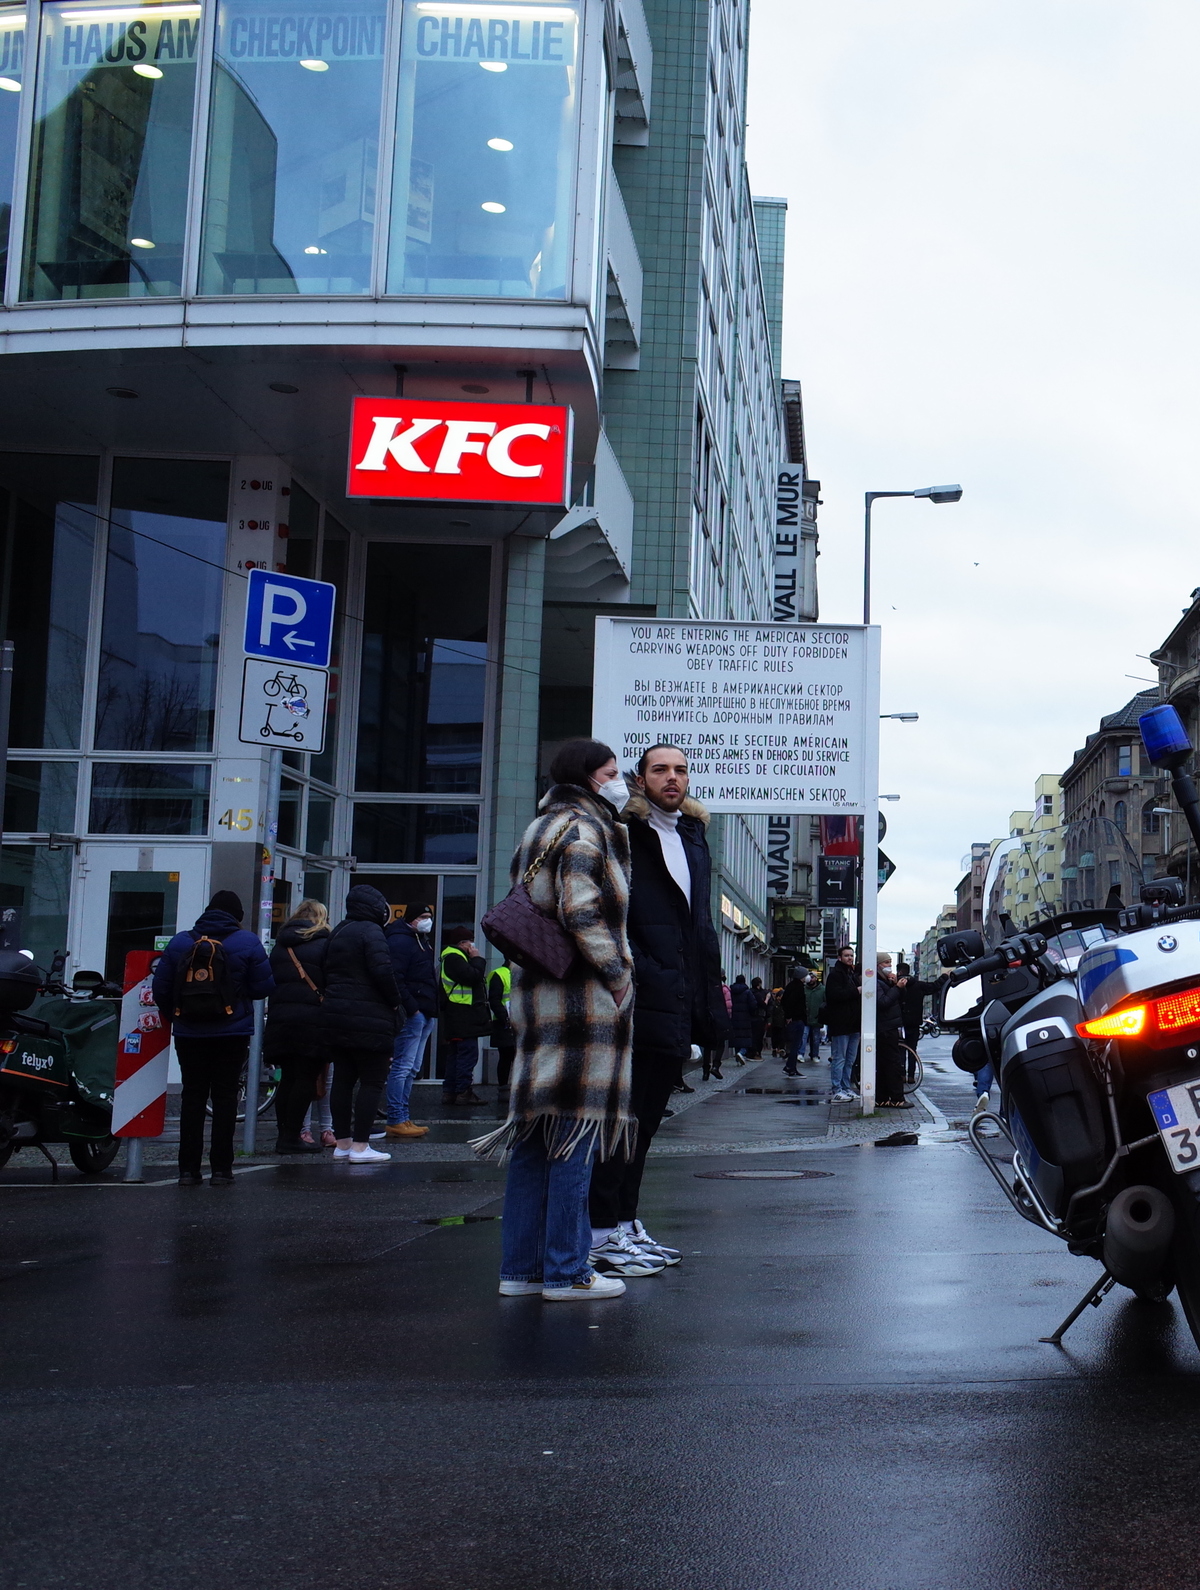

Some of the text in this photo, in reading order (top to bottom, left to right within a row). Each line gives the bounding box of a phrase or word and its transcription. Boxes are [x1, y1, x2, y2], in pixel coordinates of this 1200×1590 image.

[62, 20, 148, 66] HAUS
[230, 16, 387, 59] CHECKPOINT
[416, 15, 565, 61] CHARLIE
[355, 416, 551, 478] KFC
[240, 480, 273, 490] 2 UG
[777, 471, 800, 527] MUR
[240, 520, 270, 530] 3 UG
[775, 533, 798, 557] LE
[259, 583, 308, 647] P
[631, 626, 850, 644] YOU ARE ENTERING THE AMERICAN SECTOR
[630, 642, 848, 659] CARRYING WEAPONS OFF DUTY FORBIDDEN
[687, 658, 794, 672] OBEY TRAFFIC RULES
[634, 680, 650, 692] ВЫ
[712, 682, 718, 694] В
[723, 682, 803, 696] АМЕРИКАНСКИЙ
[808, 684, 843, 696] СЕКТОР
[624, 694, 657, 707] НОСИТЬ
[660, 695, 694, 708] ОРУЖИЕ
[750, 698, 756, 710] В
[759, 698, 820, 711] НЕСЛУЖЕБНОЕ
[822, 699, 851, 712] ВРЕМЯ
[714, 712, 772, 724] ДОРОЖНЫМ
[778, 713, 834, 726] ПРАВИЛАМ
[624, 732, 848, 748] VOUS ENTREZ DANS LE SECTEUR AMÉRICAIN
[705, 748, 720, 760] DES
[722, 749, 750, 760] ARMES
[752, 750, 763, 760] EN
[766, 750, 798, 761] DEHORS
[802, 750, 814, 762] DU
[816, 751, 850, 762] SERVICE
[690, 762, 836, 776] AUX REGLES DE CIRCULATION
[696, 786, 714, 800] DEN
[719, 786, 805, 800] AMERIKANISCHEN
[810, 788, 846, 802] SEKTOR
[218, 808, 253, 831] 45
[22, 1052, 48, 1071] felyx
[1162, 1113, 1172, 1126] D
